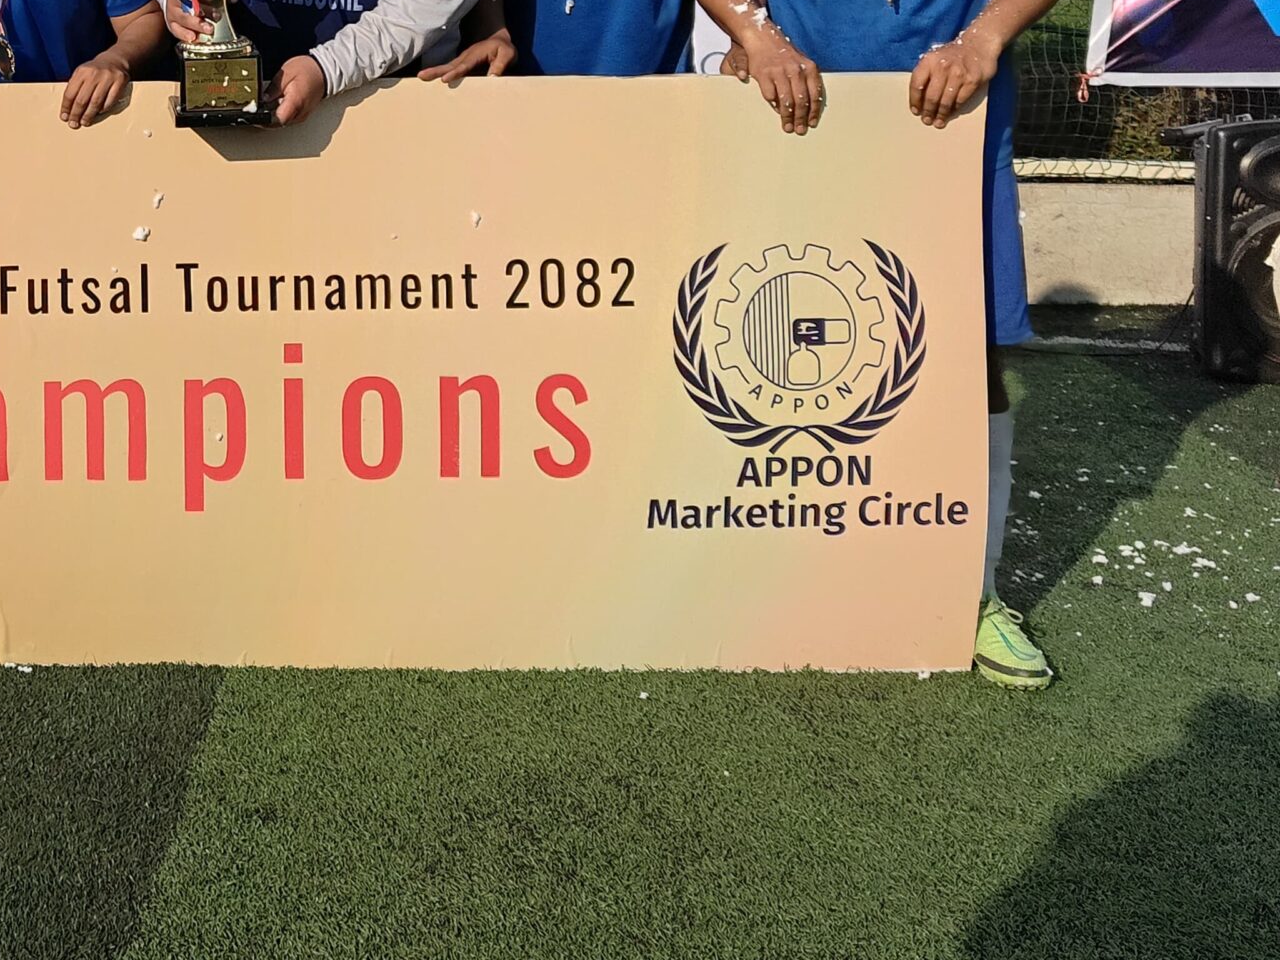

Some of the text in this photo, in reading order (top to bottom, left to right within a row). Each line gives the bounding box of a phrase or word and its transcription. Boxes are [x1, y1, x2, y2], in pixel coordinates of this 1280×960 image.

[0, 263, 150, 316] Futsal
[175, 262, 479, 313] Tournament
[505, 257, 637, 310] 2082
[748, 381, 853, 414] APPON
[736, 455, 871, 487] APPON
[647, 491, 969, 536] Marketing Circle
